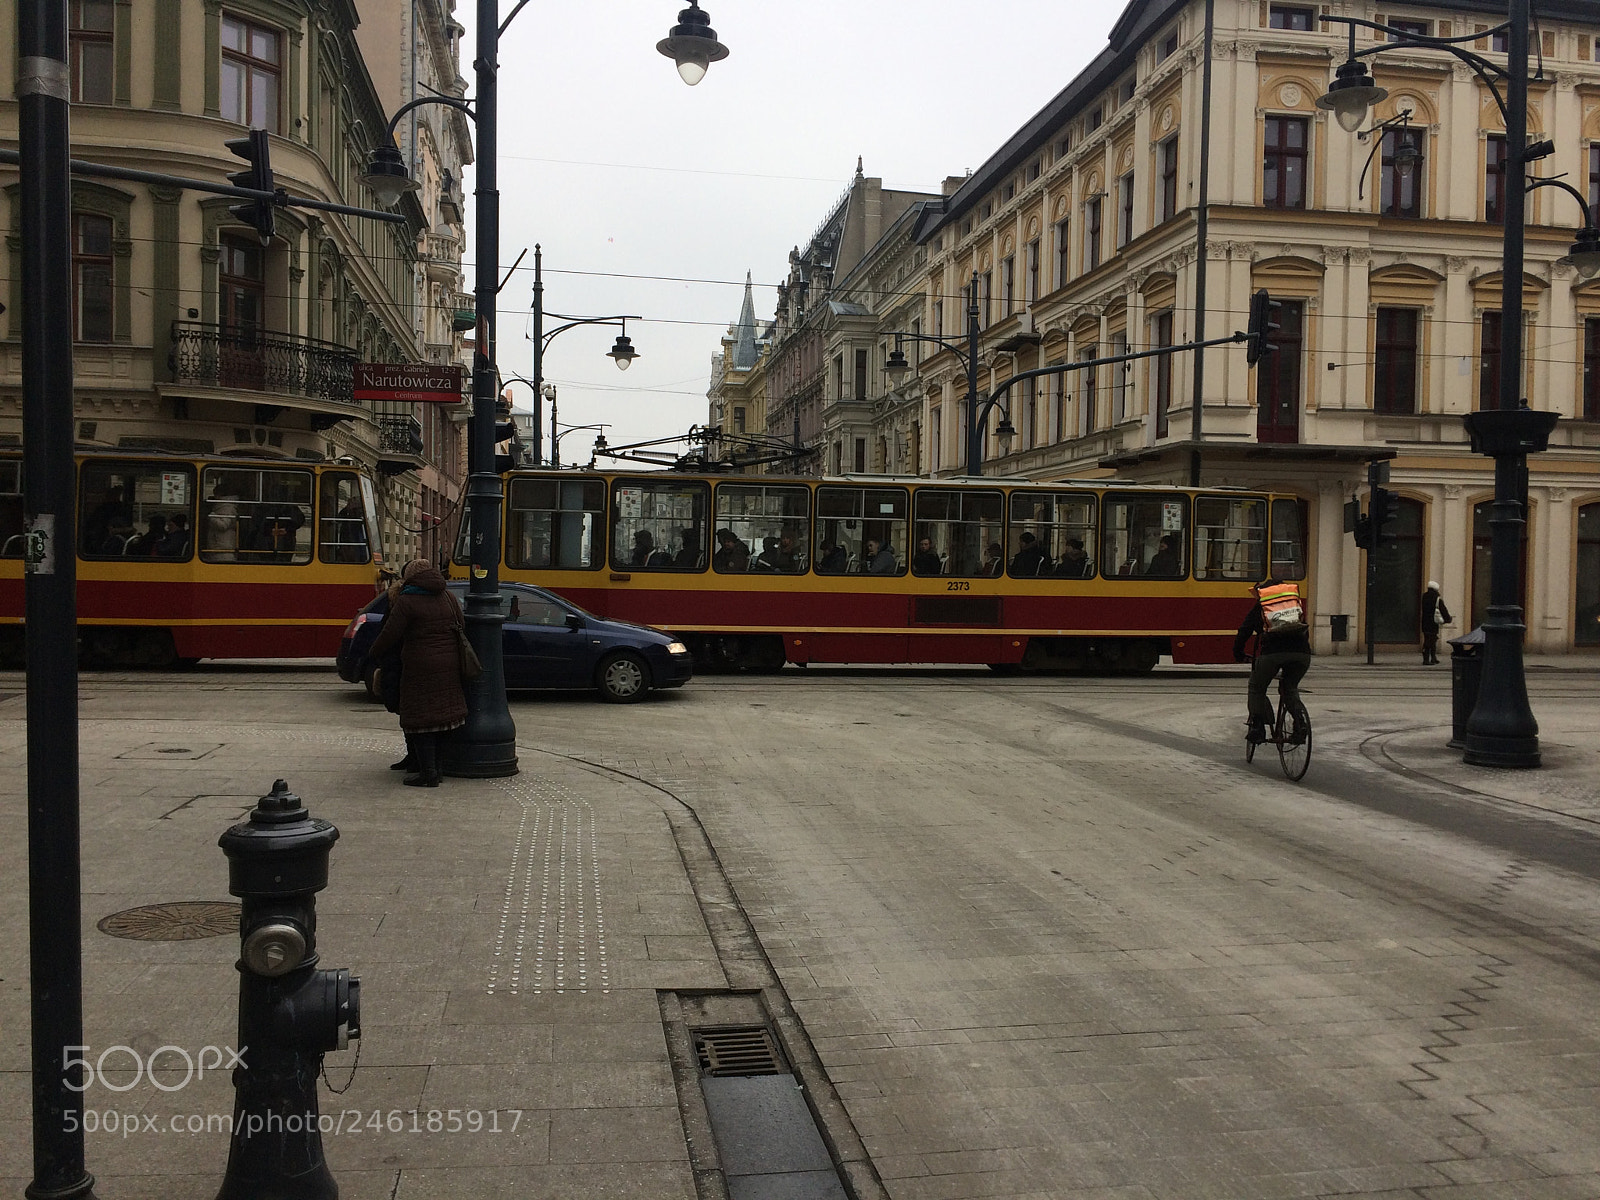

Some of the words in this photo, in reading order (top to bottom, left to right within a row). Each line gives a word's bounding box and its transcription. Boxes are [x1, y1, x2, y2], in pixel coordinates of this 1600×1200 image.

[362, 372, 452, 389] Narutowicza
[394, 391, 423, 399] Centrum
[947, 581, 970, 591] 2373
